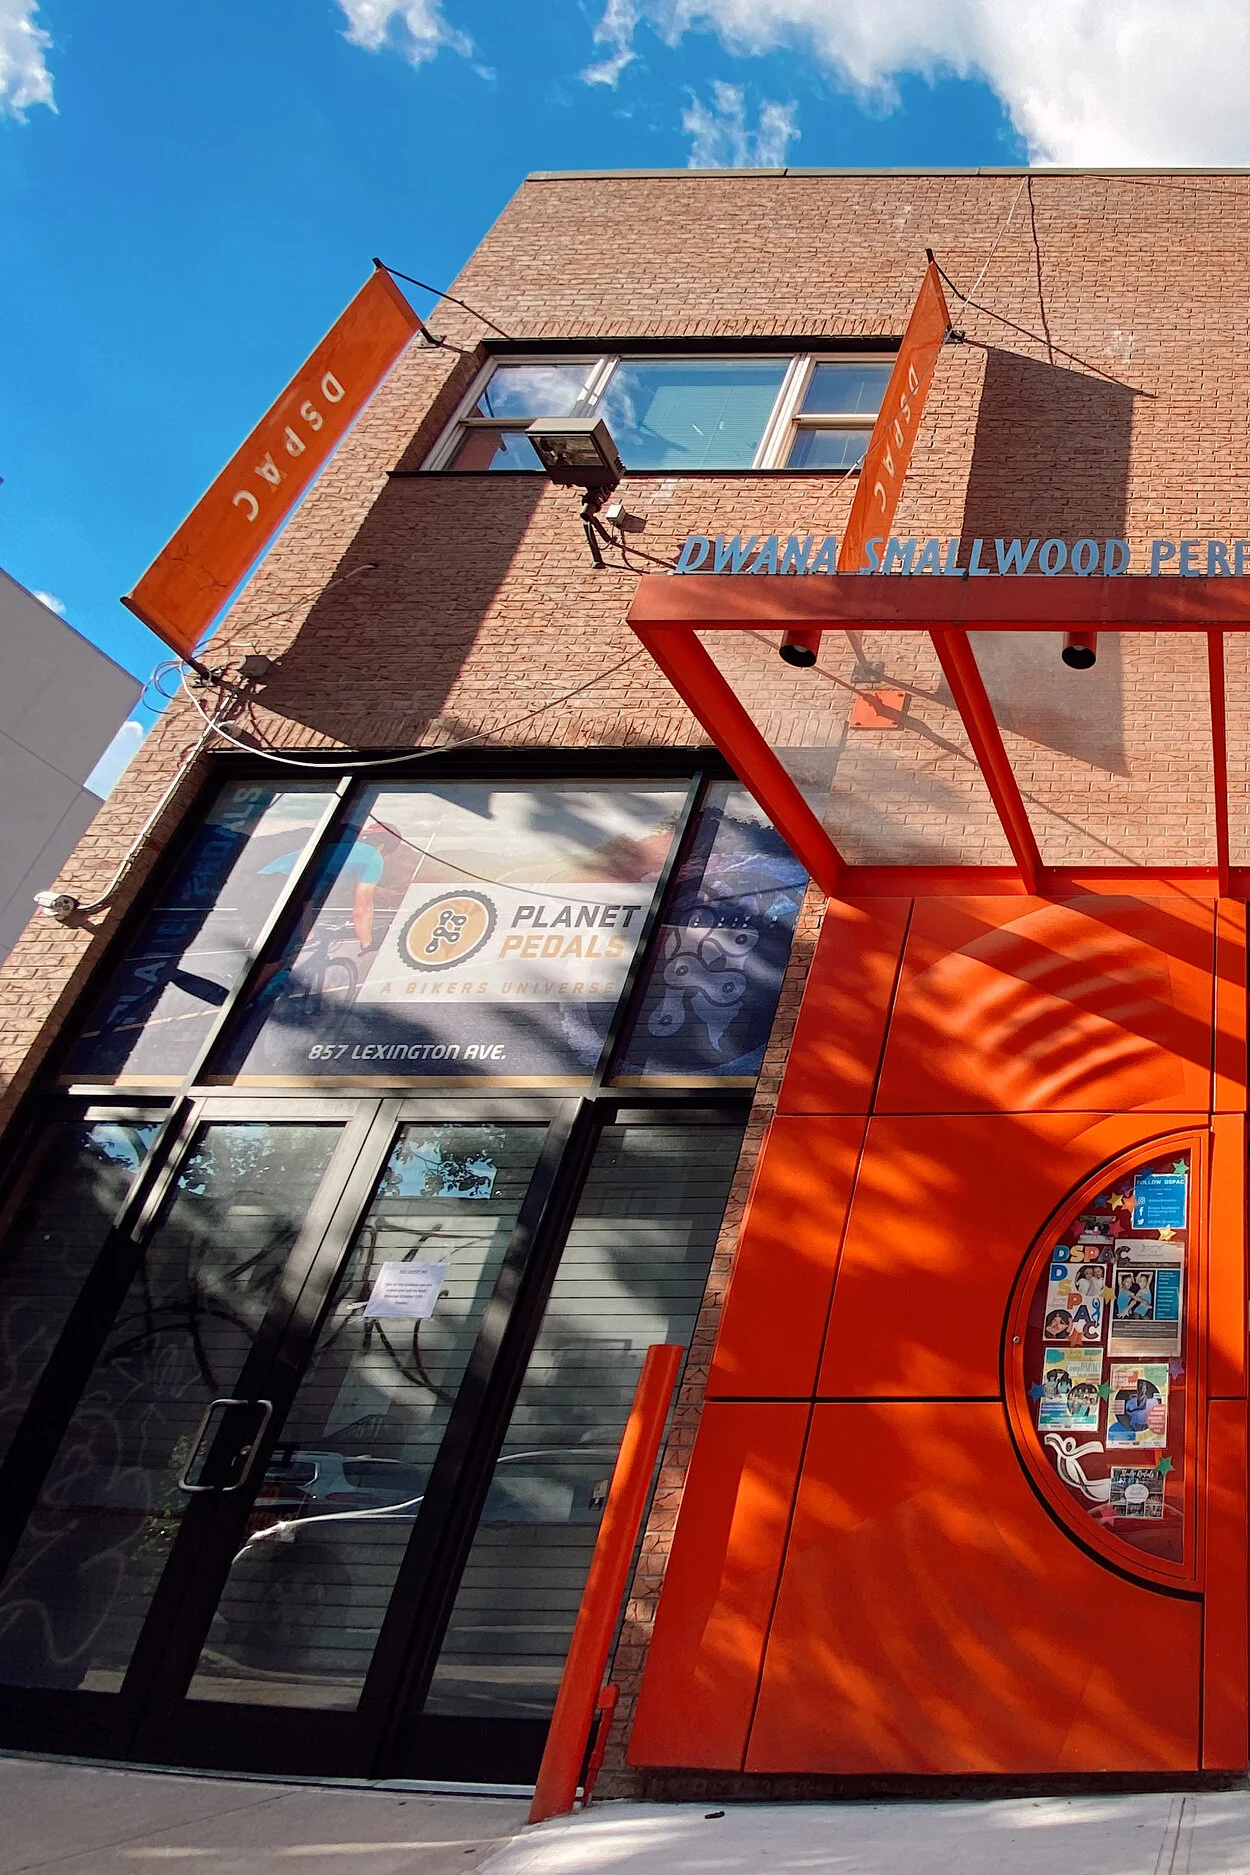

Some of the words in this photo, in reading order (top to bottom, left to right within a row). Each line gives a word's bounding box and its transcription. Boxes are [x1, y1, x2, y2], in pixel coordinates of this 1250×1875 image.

[233, 371, 346, 522] DSPAC
[674, 535, 838, 575] DWANA
[858, 537, 1132, 576] SMALLWOOD
[510, 905, 642, 928] PLANET
[497, 934, 628, 959] PEDALS
[379, 982, 393, 994] A
[405, 982, 489, 994] BIKERS
[501, 982, 616, 994] UNIVERSE
[308, 1044, 349, 1060] 857
[351, 1044, 460, 1060] LEXINGTON
[463, 1044, 507, 1060] AVE.
[1052, 1244, 1132, 1265] DSPAC
